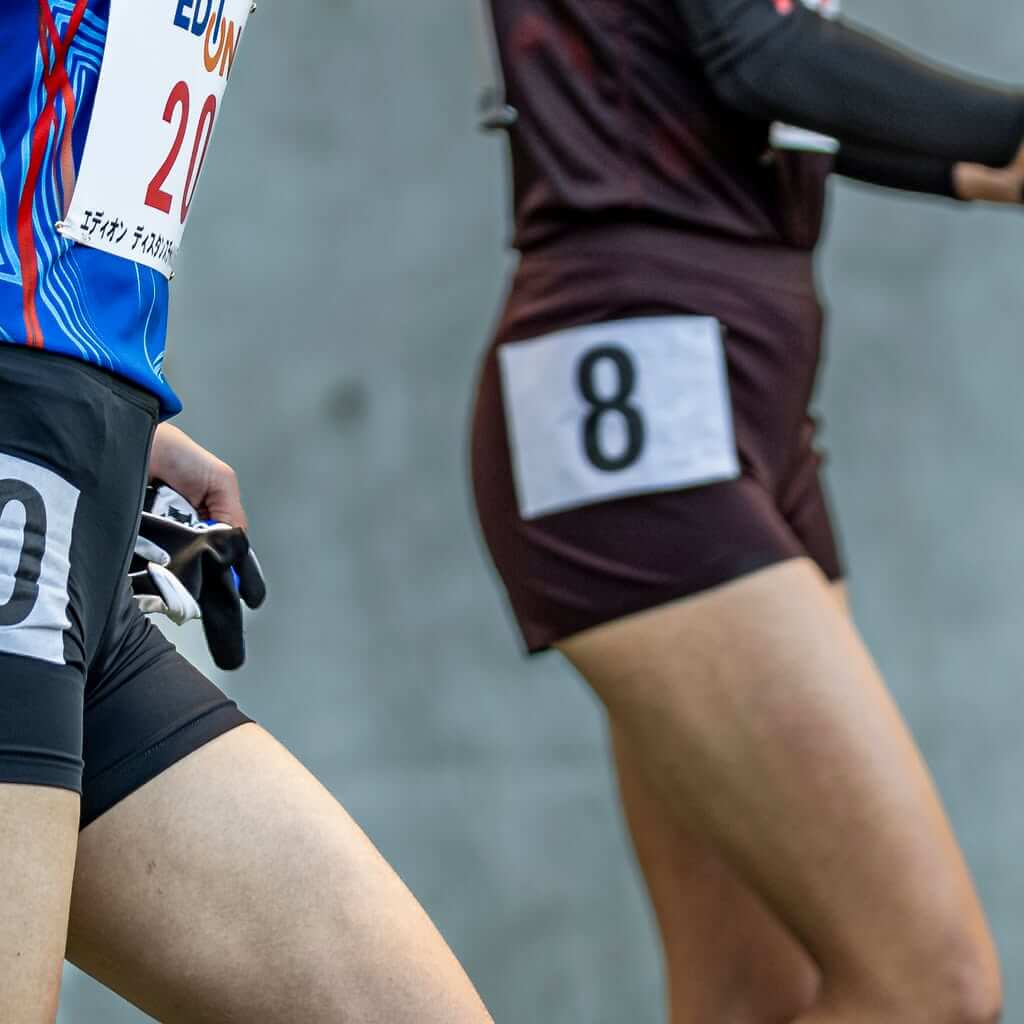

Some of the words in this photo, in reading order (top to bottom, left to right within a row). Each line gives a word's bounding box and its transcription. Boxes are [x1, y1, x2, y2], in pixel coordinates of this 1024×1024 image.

[79, 210, 128, 244] エディオン
[578, 344, 645, 473] 8
